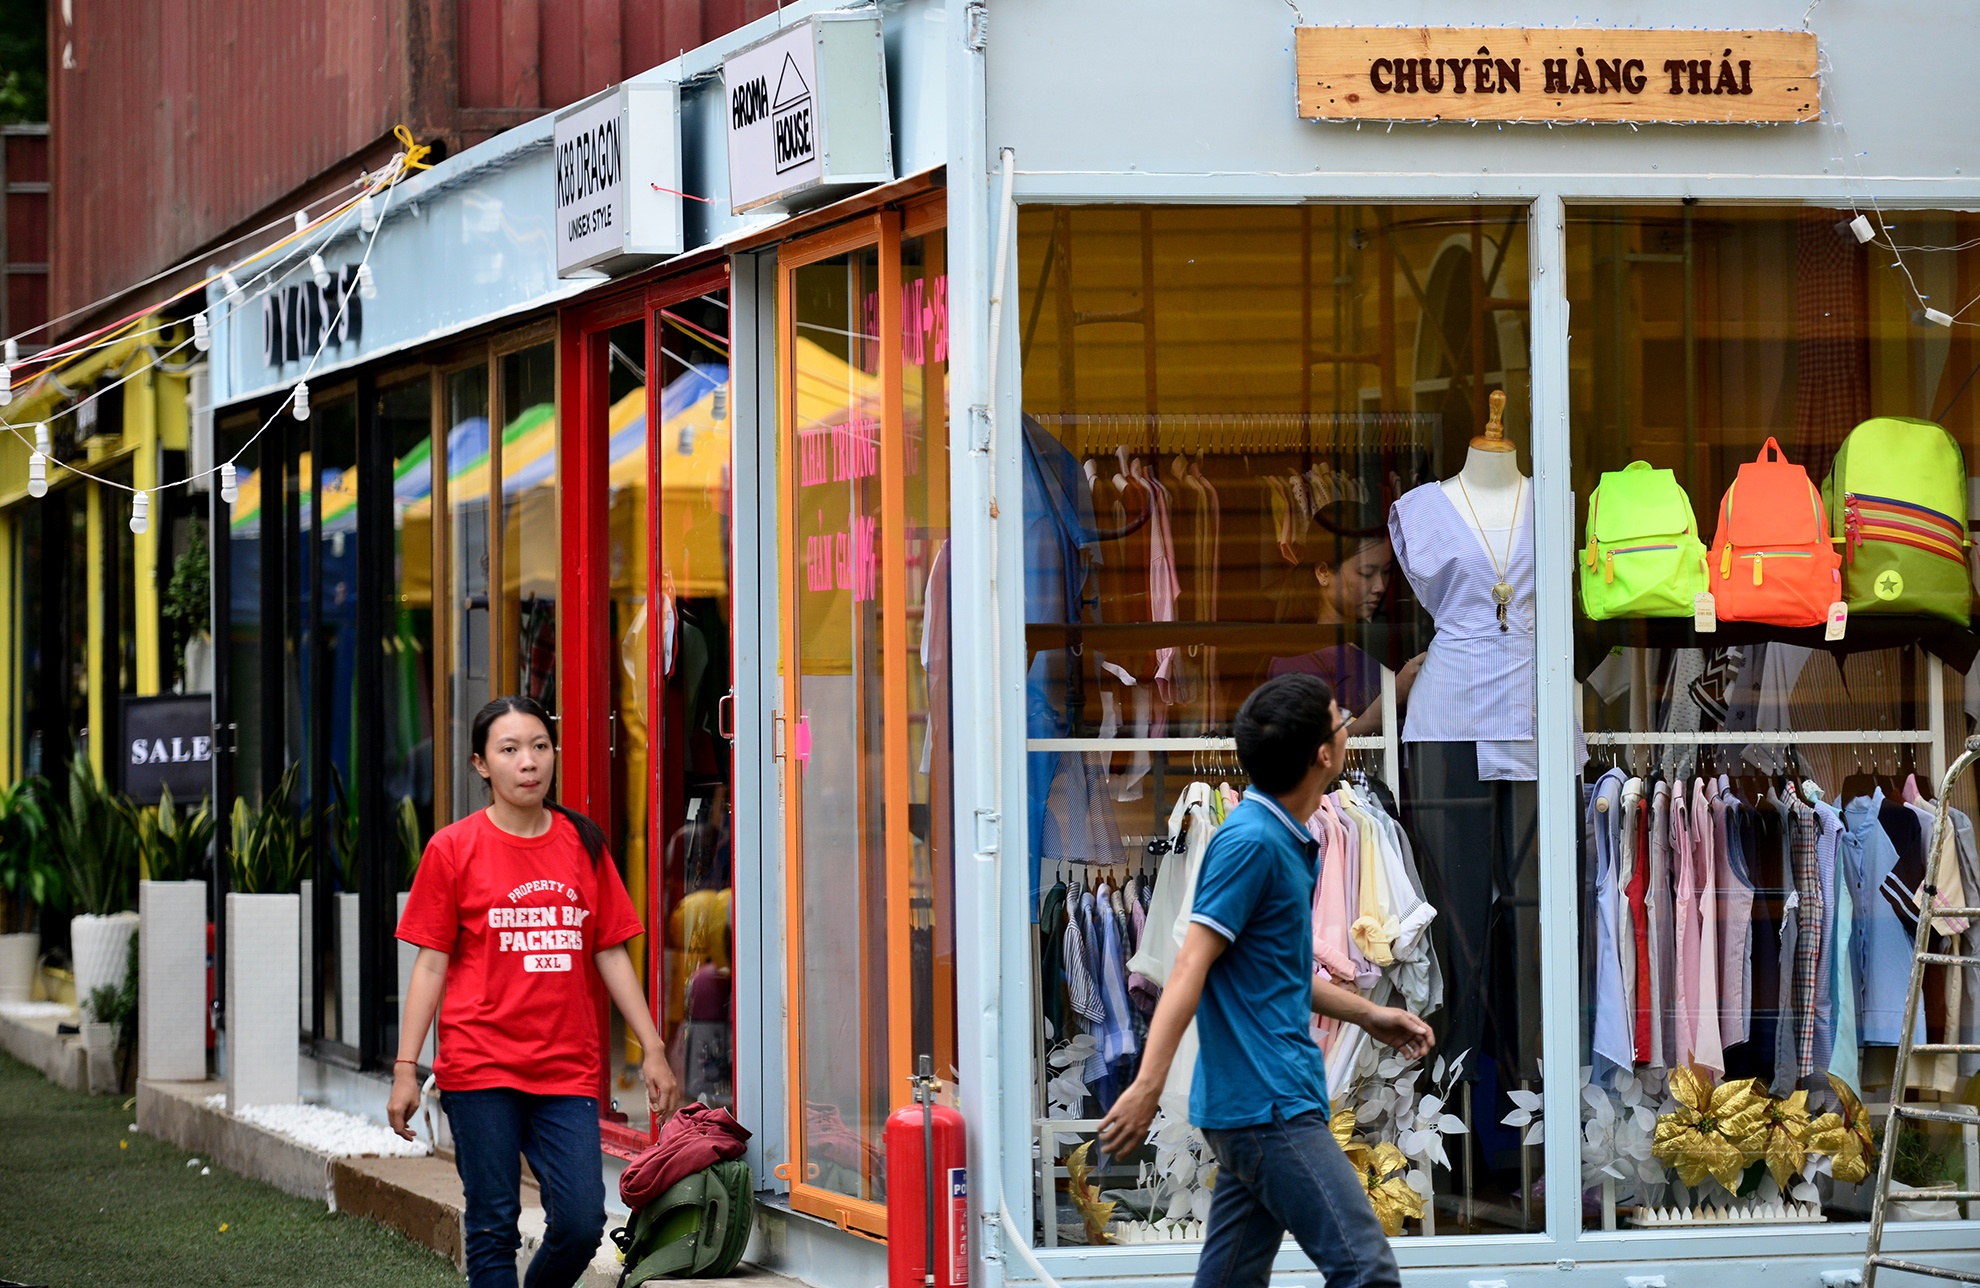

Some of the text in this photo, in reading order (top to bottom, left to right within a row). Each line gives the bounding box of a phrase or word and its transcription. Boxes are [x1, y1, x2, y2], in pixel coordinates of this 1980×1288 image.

[1370, 45, 1753, 95] CHUYÊN HÀNG THÁI
[732, 74, 769, 131] AROMA
[776, 108, 811, 163] HOUSE
[556, 116, 622, 209] K88 DRAGON
[568, 203, 612, 243] UNISEX STYLE
[901, 277, 925, 368] 00K
[800, 426, 828, 487] KHAI
[853, 515, 876, 602] 10%
[131, 735, 212, 765] SALE
[507, 880, 565, 903] PROPERTY
[488, 906, 558, 929] GREEN
[499, 929, 583, 952] PACKERS
[534, 957, 561, 969] XXL
